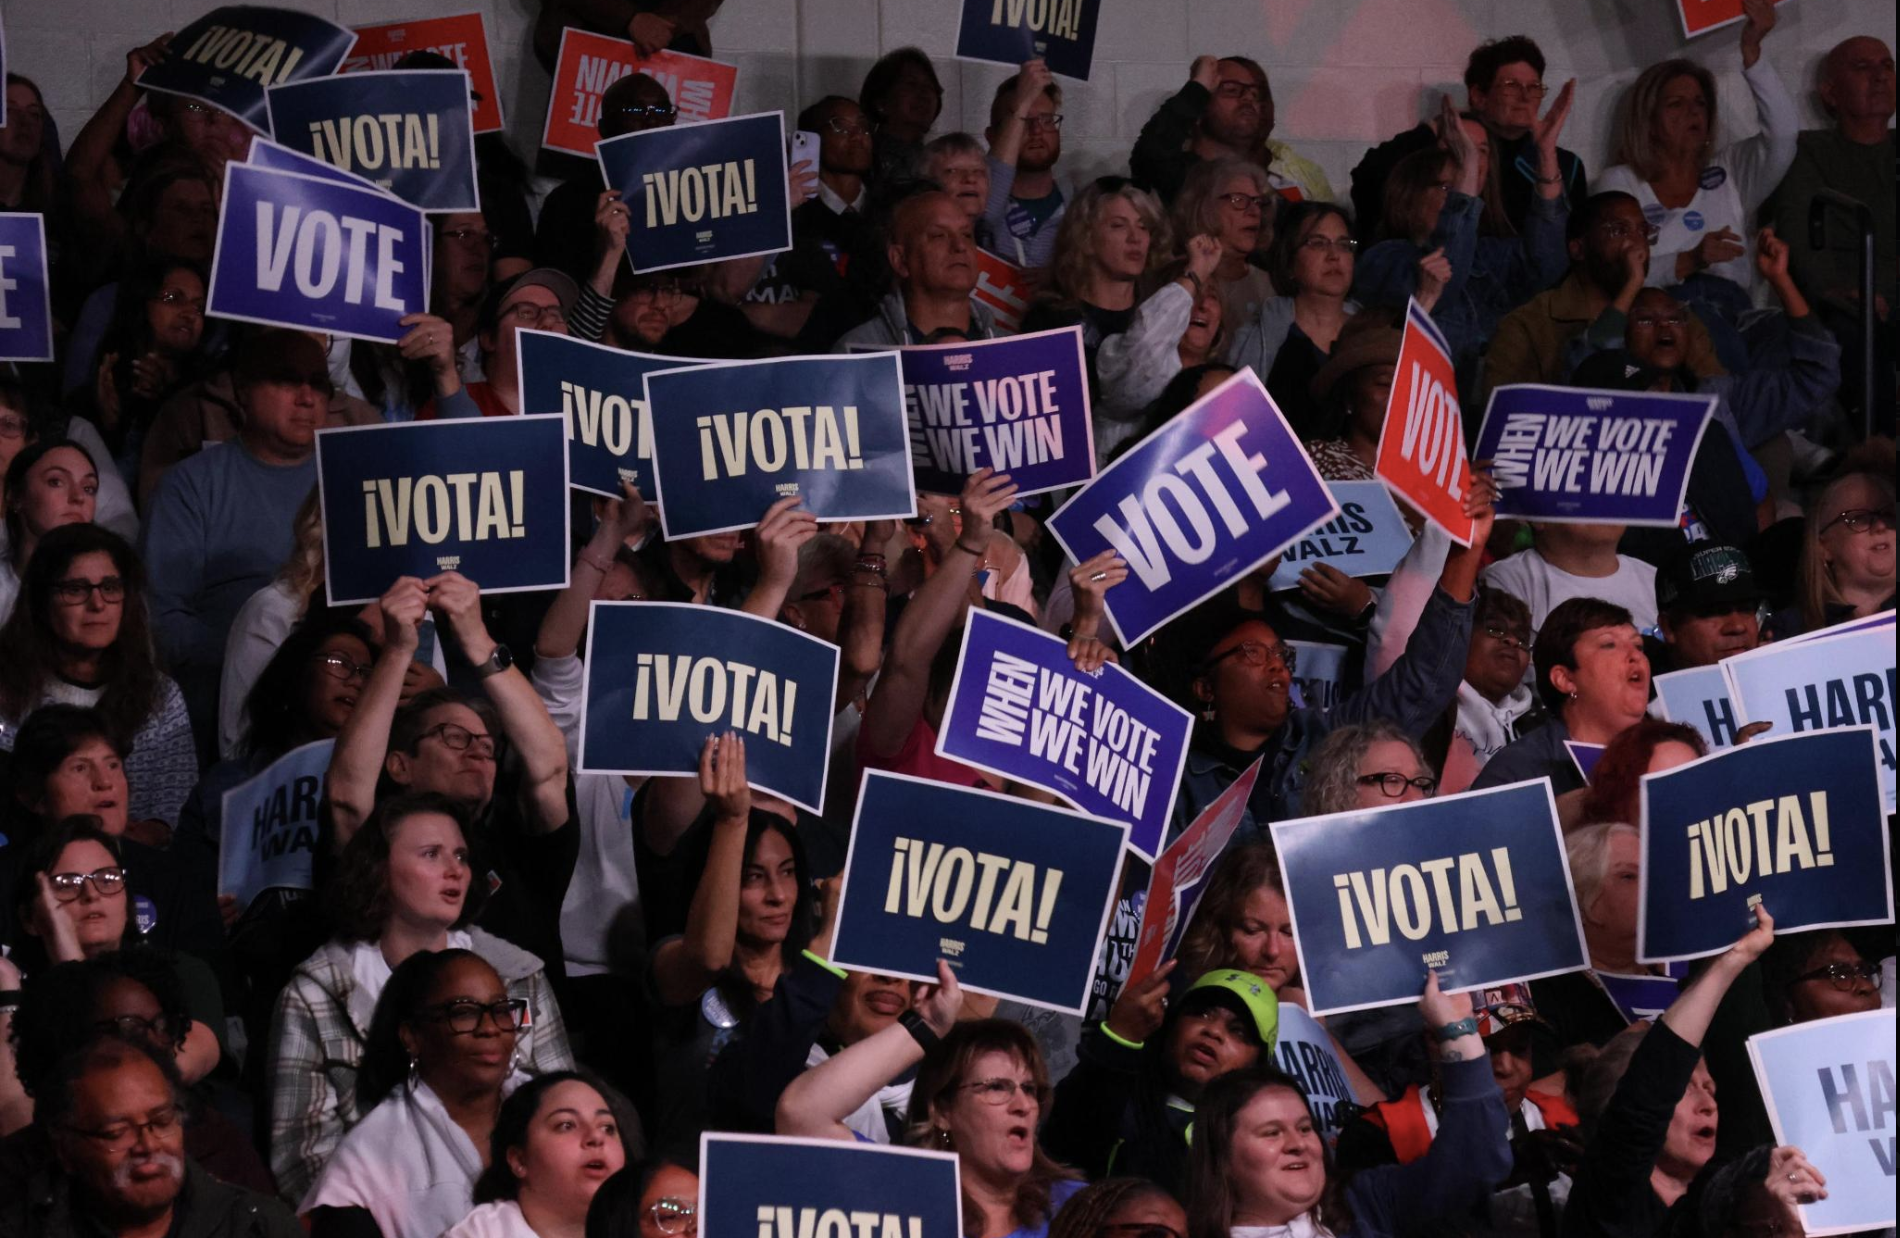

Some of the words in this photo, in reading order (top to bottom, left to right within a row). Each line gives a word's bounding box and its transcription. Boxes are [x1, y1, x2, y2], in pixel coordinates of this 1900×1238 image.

[183, 25, 304, 86] ¡VOTA!
[309, 113, 440, 170] ¡VOTA!
[643, 159, 757, 228] ¡VOTA!
[256, 200, 406, 312] VOTE
[561, 381, 651, 459] ¡VOT
[917, 383, 973, 427] WE
[974, 370, 1060, 424] VOTE
[1401, 361, 1467, 501] VOTE
[1544, 415, 1598, 449] WE
[1598, 417, 1678, 453] VOTE
[697, 406, 863, 481] ¡VOTA!
[926, 427, 984, 475] WE
[984, 414, 1065, 473] WIN
[1492, 413, 1547, 501] WHEN
[1534, 449, 1589, 493] WE
[1590, 451, 1667, 497] WIN
[363, 470, 525, 548] ¡VOTA!
[1093, 419, 1291, 592] VOTE
[632, 653, 797, 747] ¡VOTA!
[976, 650, 1039, 746] WHEN
[1039, 667, 1092, 727] WE
[1093, 692, 1161, 774] VOTE
[1029, 708, 1087, 776] WE
[1086, 736, 1152, 820] WIN
[253, 775, 318, 850] HAR
[260, 826, 314, 863] WA
[1687, 790, 1834, 899] ¡VOTA!
[884, 836, 1063, 944] ¡VOTA!
[1334, 847, 1522, 949] ¡VOTA!
[1423, 950, 1449, 963] HARRIS
[1428, 960, 1446, 968] WALZ
